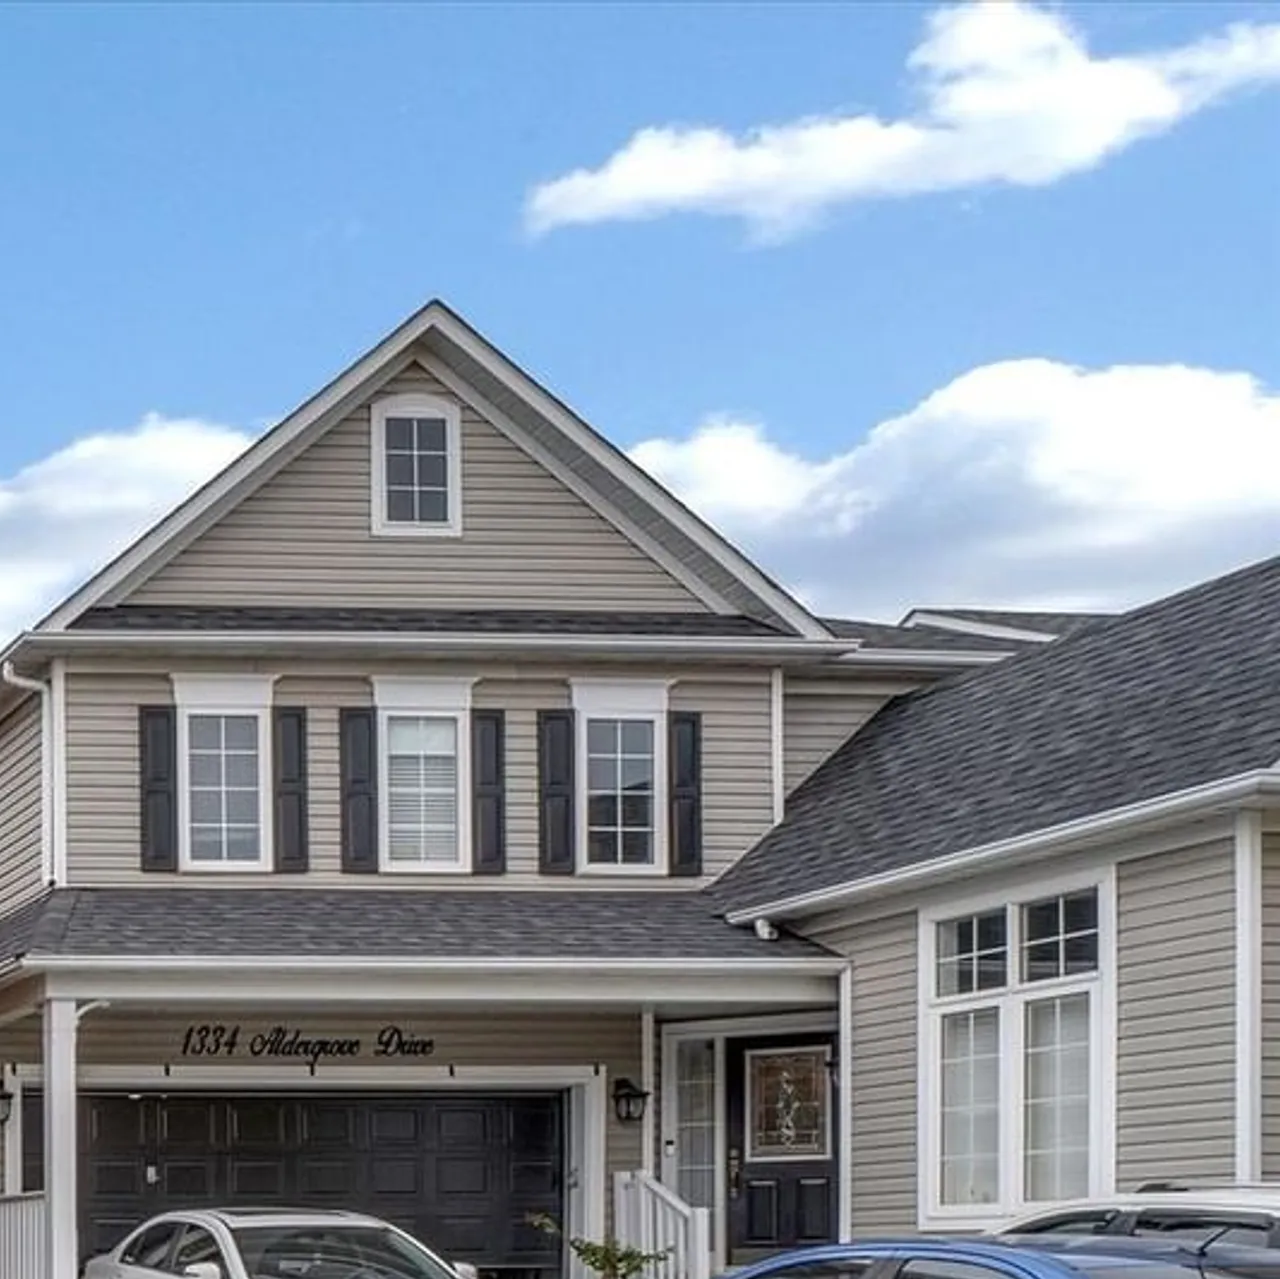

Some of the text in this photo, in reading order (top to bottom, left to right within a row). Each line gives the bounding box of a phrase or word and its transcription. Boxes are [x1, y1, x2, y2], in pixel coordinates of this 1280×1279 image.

[181, 1025, 436, 1063] 1334 Aldergrove Drive
